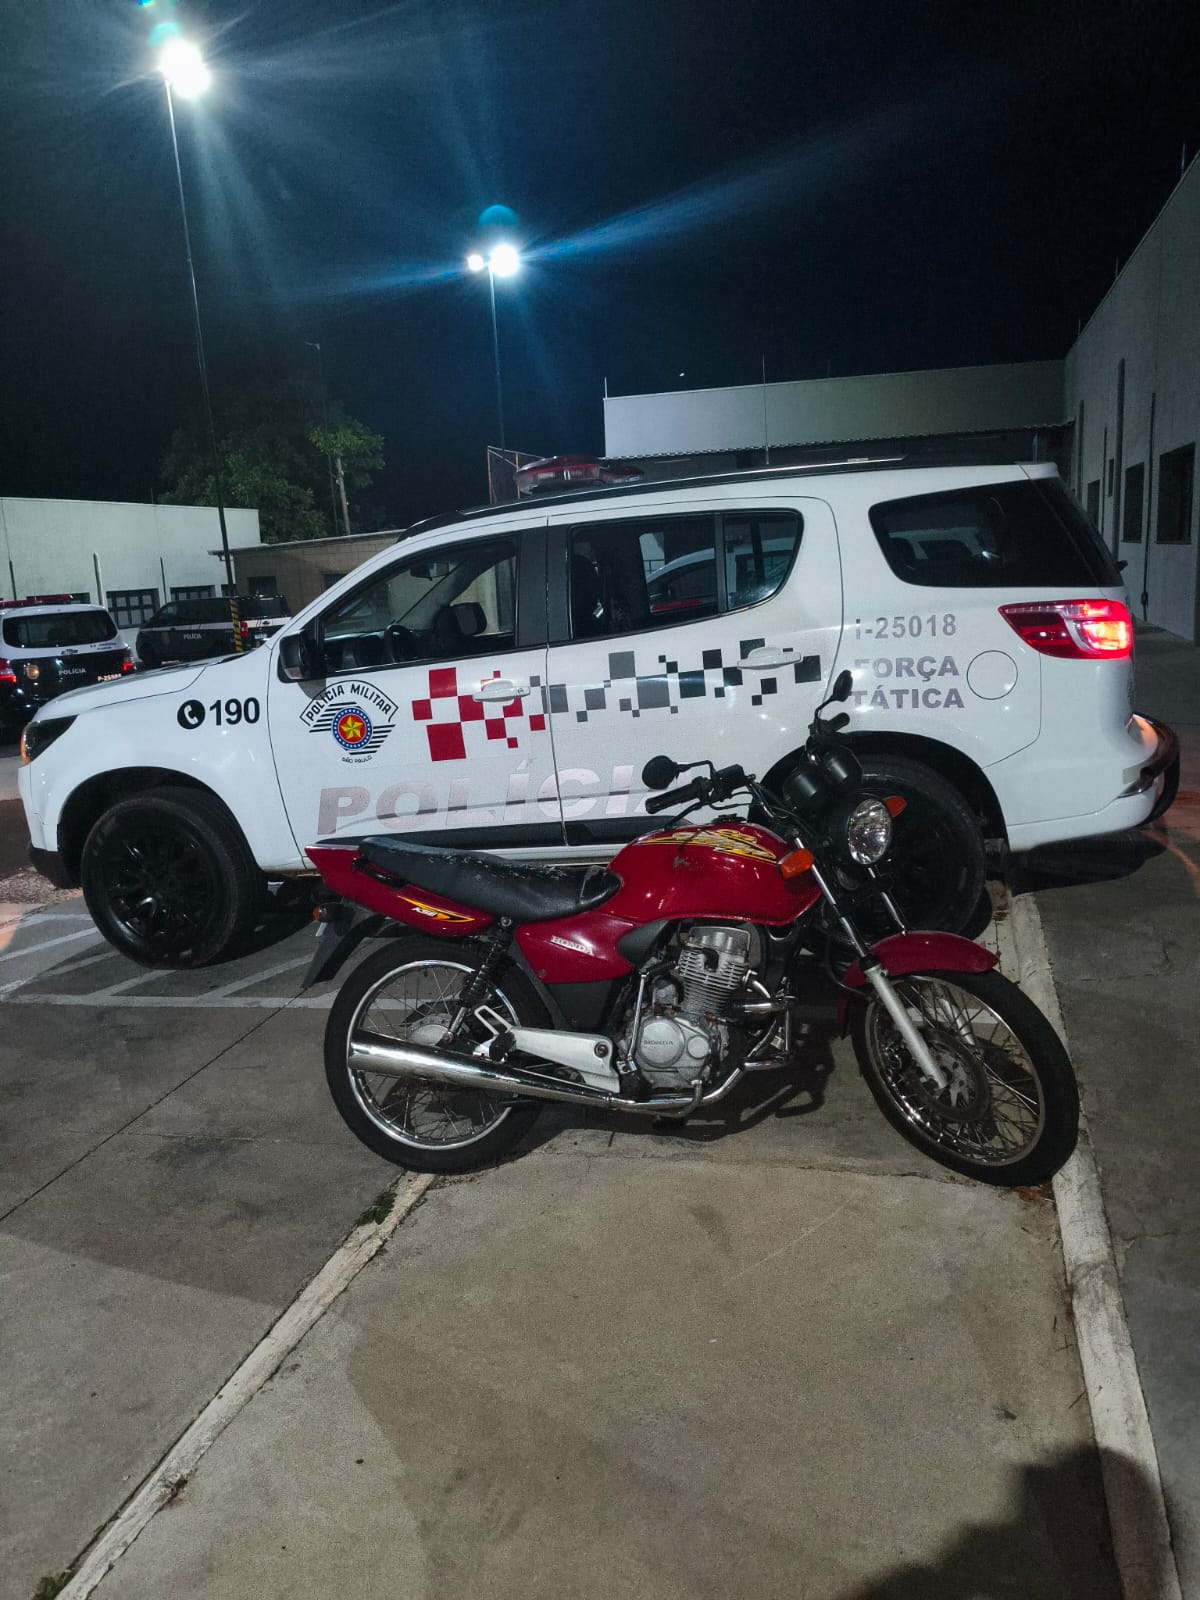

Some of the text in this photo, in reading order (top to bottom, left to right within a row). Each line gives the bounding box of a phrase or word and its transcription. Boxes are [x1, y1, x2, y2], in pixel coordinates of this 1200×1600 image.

[854, 655, 960, 682] FORÇA
[350, 683, 392, 715] MILITAR
[850, 684, 965, 709] TÁTICA
[209, 697, 260, 726] 190
[550, 935, 595, 957] HONDA
